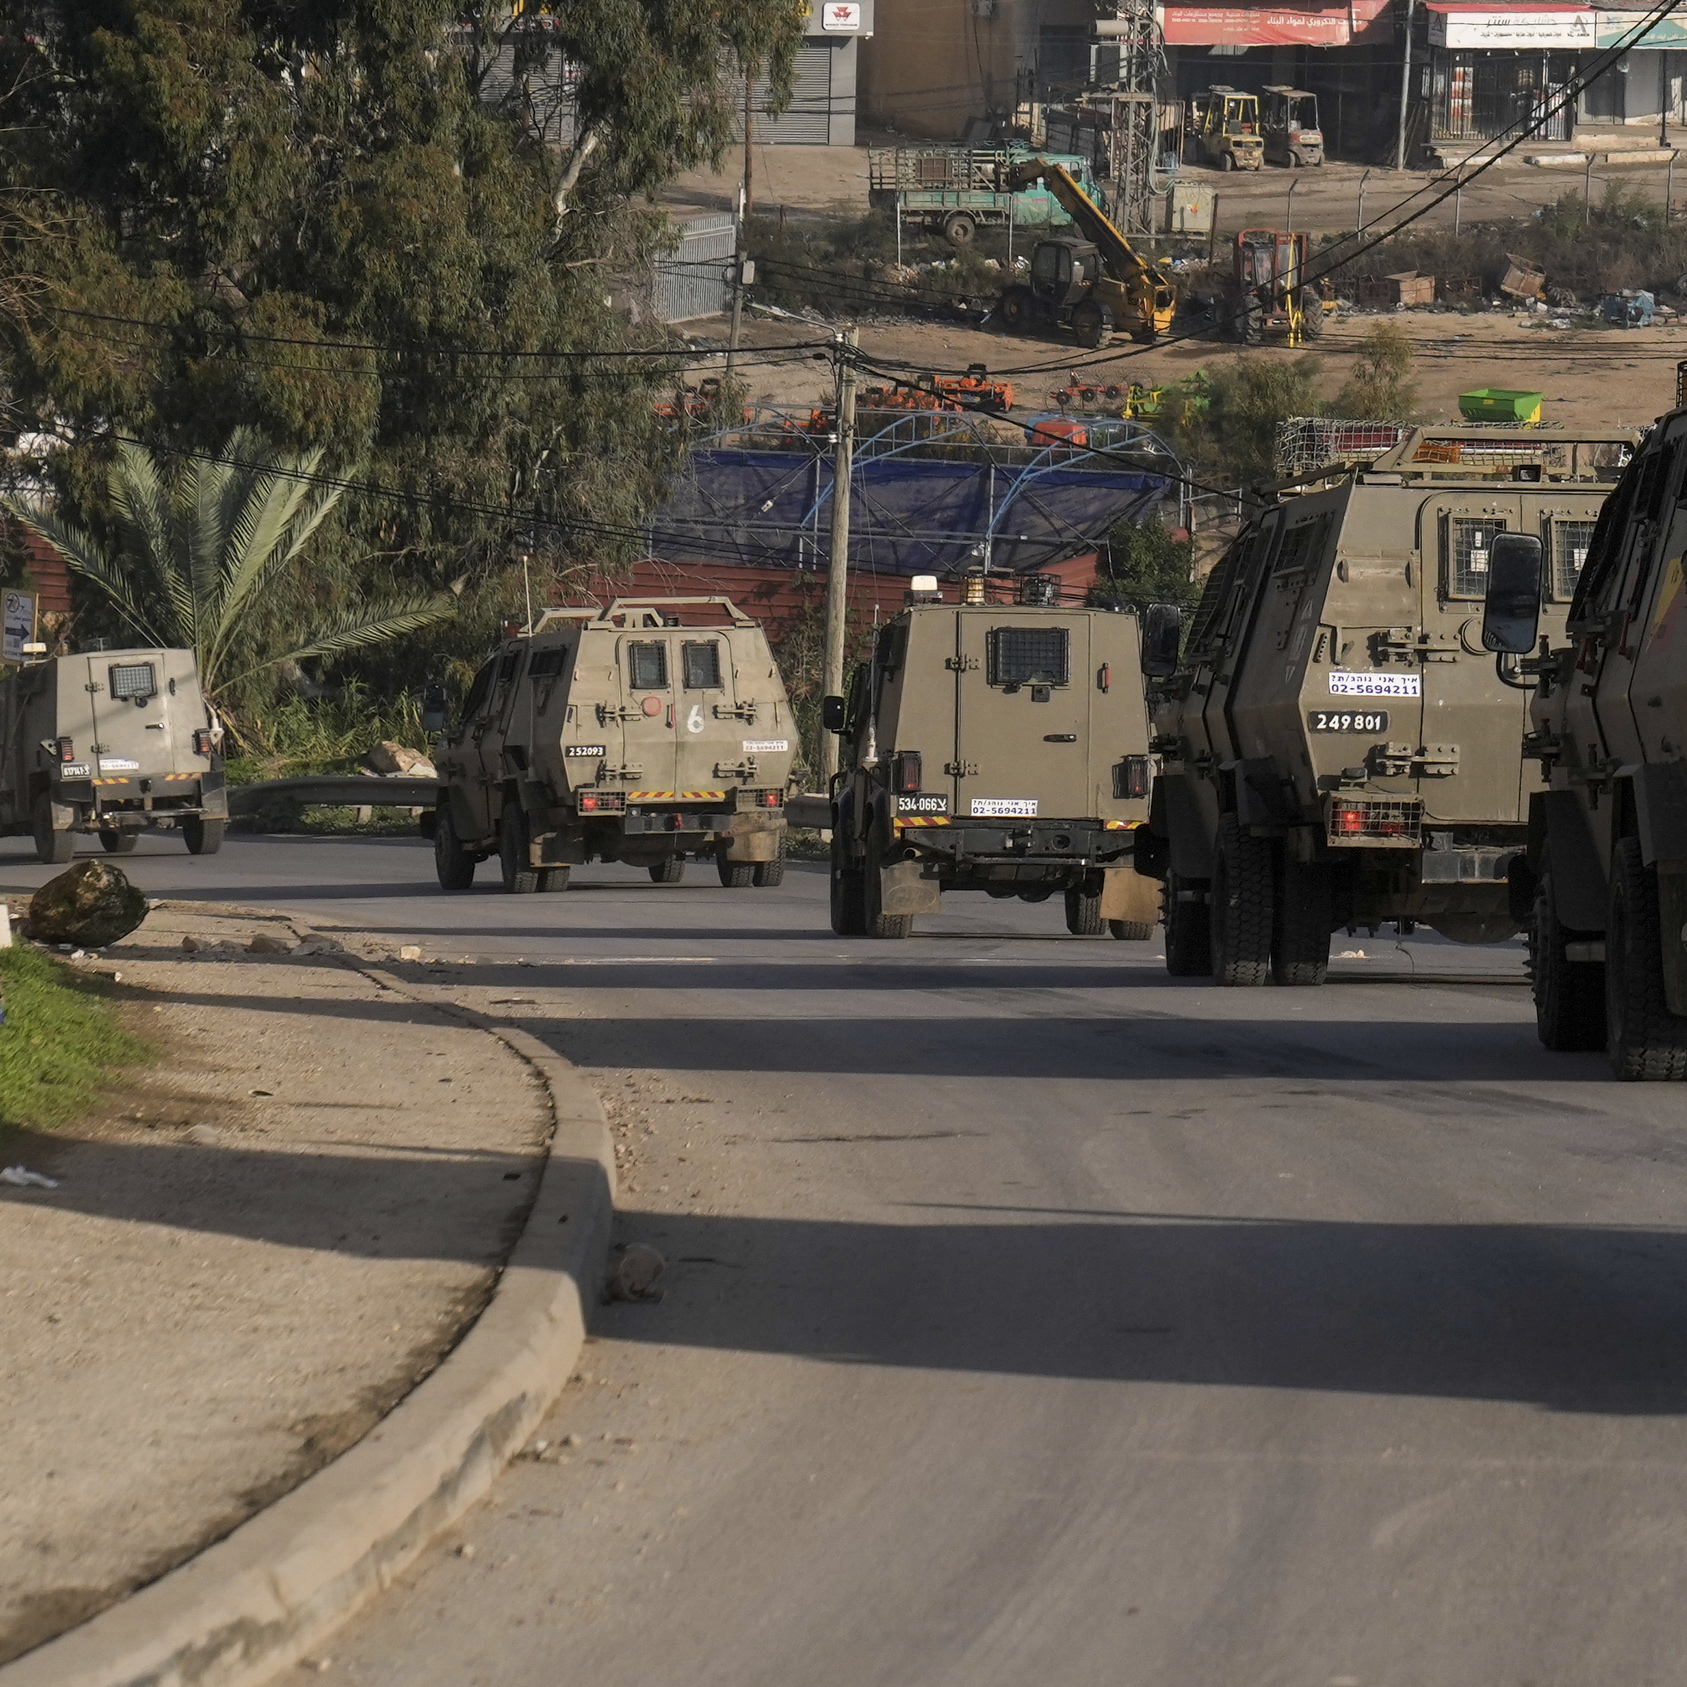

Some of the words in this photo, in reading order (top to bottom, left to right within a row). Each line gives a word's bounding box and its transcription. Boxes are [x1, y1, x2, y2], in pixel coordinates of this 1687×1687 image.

[1379, 675, 1396, 683] אני
[1331, 684, 1418, 695] 02-5694211
[687, 704, 705, 734] 6
[569, 746, 604, 756] 252093
[973, 807, 1036, 815] 02-5694211
